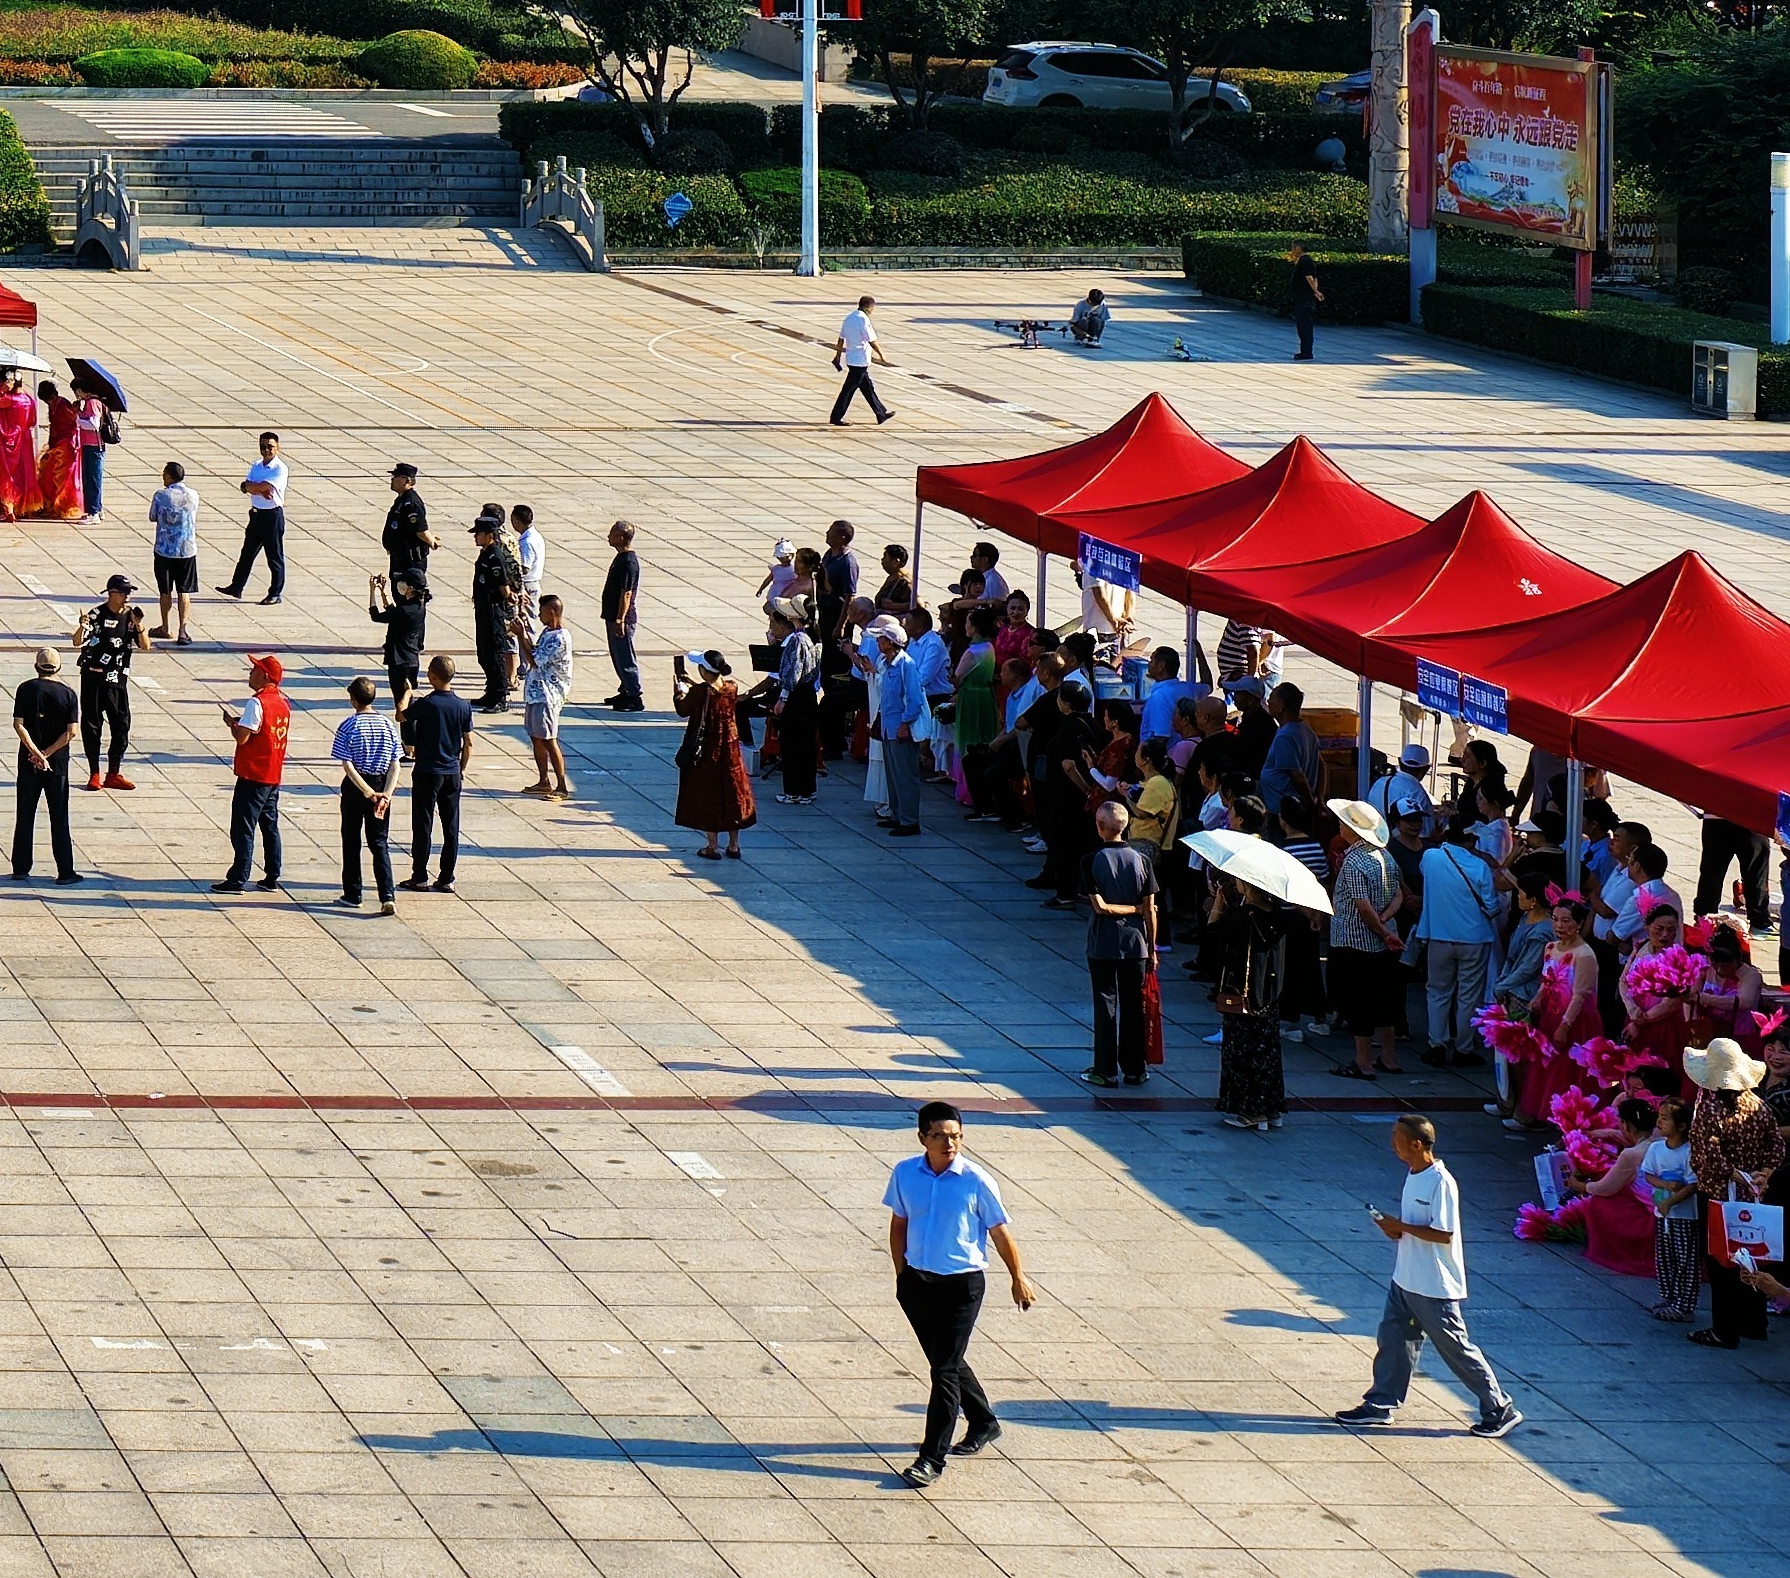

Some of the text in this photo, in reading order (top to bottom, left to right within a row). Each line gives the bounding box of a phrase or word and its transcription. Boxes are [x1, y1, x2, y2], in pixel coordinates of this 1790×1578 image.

[1448, 104, 1580, 152] 党在我心中 永远跟党走
